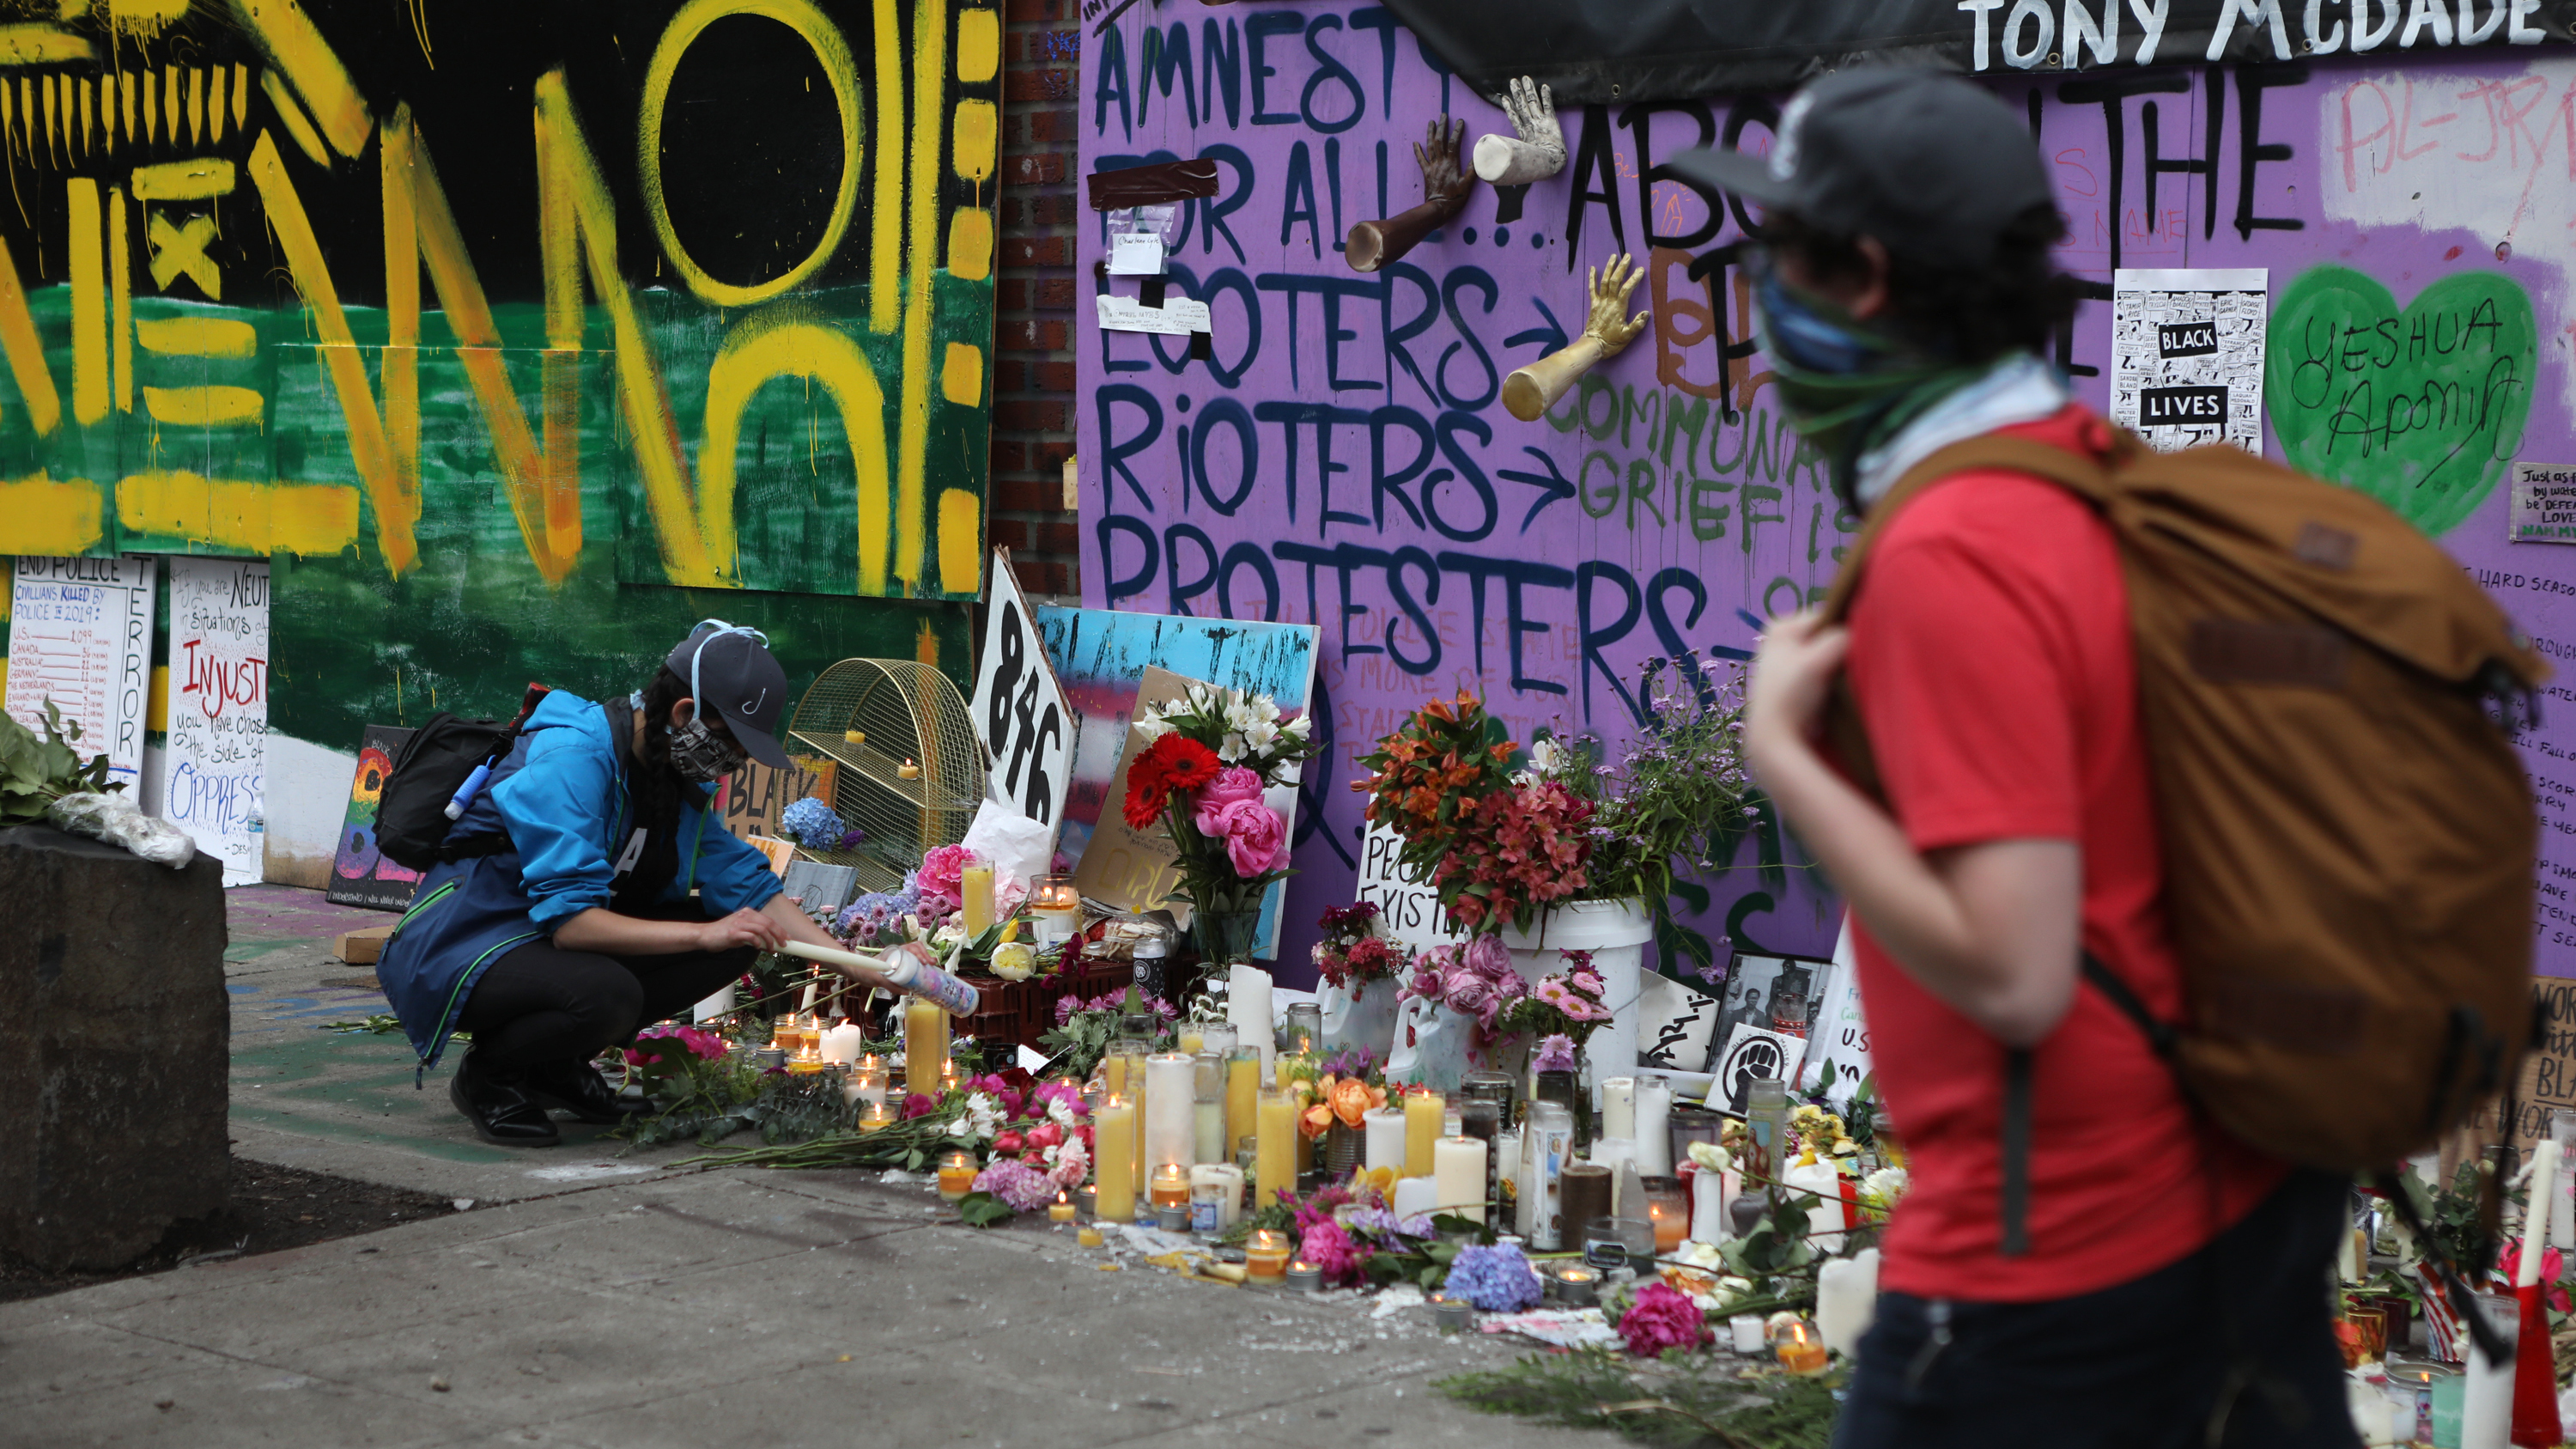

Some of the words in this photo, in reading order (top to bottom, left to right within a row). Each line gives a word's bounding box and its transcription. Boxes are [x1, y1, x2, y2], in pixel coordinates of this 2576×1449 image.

[1957, 0, 2170, 71] TONY
[2057, 64, 2312, 268] THE
[2241, 307, 2258, 316] FLOYD
[2242, 300, 2261, 308] GEORGE
[2161, 328, 2215, 350] BLACK
[2292, 298, 2503, 410] YESHUA
[2150, 394, 2221, 417] LIVES
[2523, 470, 2551, 484] Just
[2554, 472, 2569, 484] as
[1579, 450, 1786, 555] GRIEF
[2525, 498, 2540, 510] be
[2533, 486, 2548, 500] by
[18, 556, 46, 576] END
[52, 557, 121, 582] POLICE
[191, 580, 213, 610] you
[215, 579, 230, 596] are
[230, 563, 269, 610] NEUT
[2478, 568, 2526, 589] HARD
[2530, 576, 2576, 596] SEASO
[60, 586, 90, 602] KILLED
[92, 588, 106, 605] BY
[14, 603, 50, 621] POLICE
[54, 605, 63, 620] IN
[64, 605, 100, 624] 2019:
[13, 627, 30, 641] U.S.
[70, 629, 93, 645] 1,099
[180, 613, 190, 636] in
[191, 606, 252, 642] situations
[255, 610, 269, 647] of
[11, 642, 39, 655] CANADA
[118, 557, 153, 758] TERROR
[183, 639, 268, 718] INJUSTI
[2536, 685, 2576, 702] WATE
[174, 712, 203, 747] you
[210, 709, 234, 740] have
[185, 734, 209, 770] the
[210, 739, 246, 764] side
[251, 739, 264, 767] of
[2509, 731, 2533, 749] ILL
[2539, 740, 2565, 759] FALL
[2538, 776, 2576, 798] SCOR
[231, 843, 251, 855] DES
[1731, 1032, 1753, 1051] BLACK
[1759, 1029, 1778, 1040] LIVES
